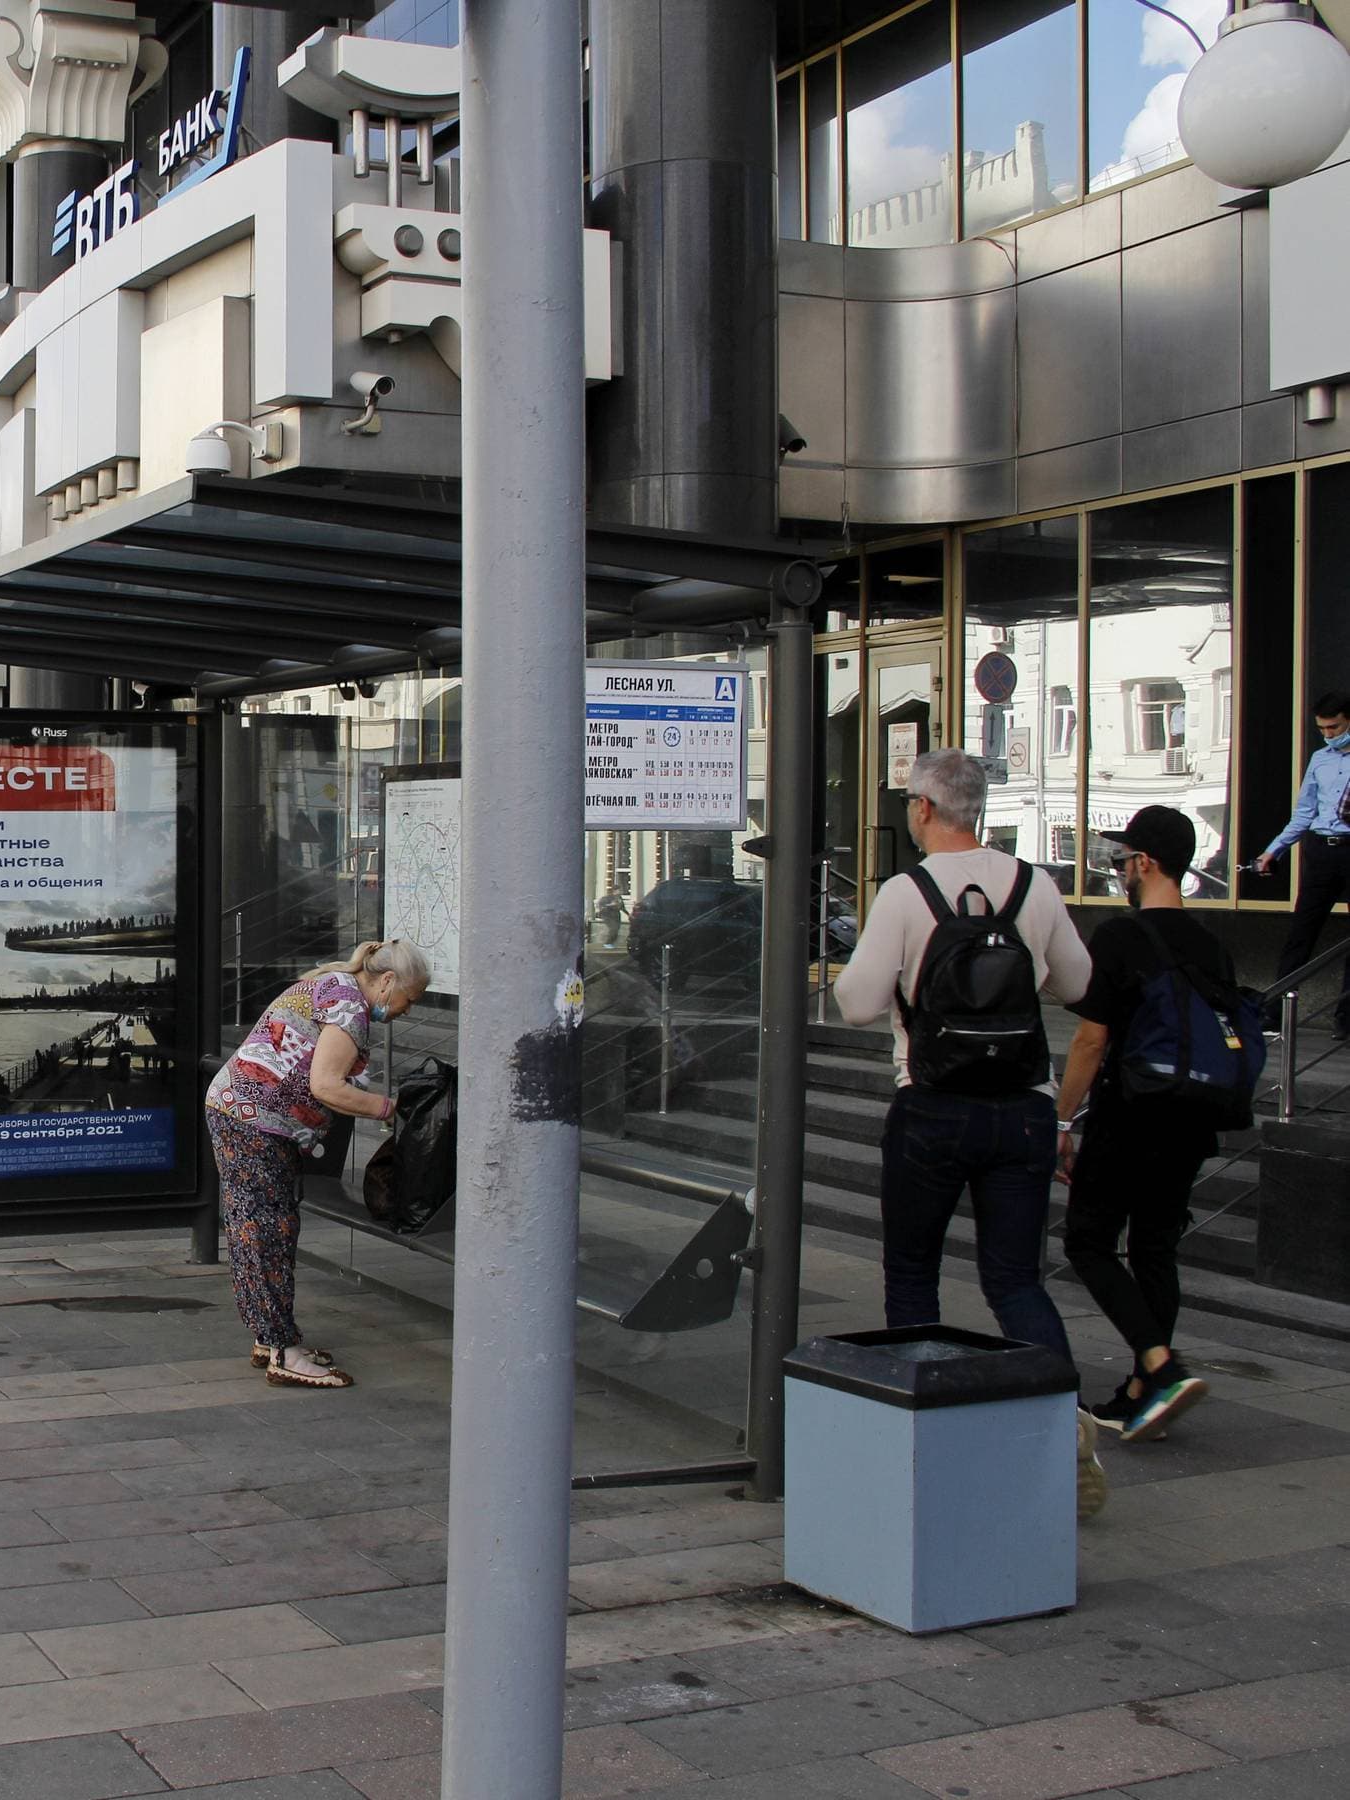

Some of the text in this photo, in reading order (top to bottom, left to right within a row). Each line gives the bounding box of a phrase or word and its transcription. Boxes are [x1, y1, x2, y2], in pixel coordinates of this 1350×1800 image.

[158, 89, 219, 176] БАНК
[75, 159, 137, 265] ВТБ
[605, 677, 676, 693] ЛЕСНАЯ УЛ.
[43, 727, 68, 737] Russ
[589, 723, 619, 735] МЕТРО
[586, 735, 638, 749] ТАЙ-ГОРОД"
[667, 731, 677, 742] 24
[588, 756, 618, 768] МЕТРО
[585, 768, 638, 779] ЯКОВСКАЯ"
[586, 794, 639, 808] ОТЁЧНАЯ ПЛ.
[14, 878, 24, 888] и
[27, 876, 103, 889] общения
[32, 1118, 38, 1127] В
[39, 1114, 127, 1127] ГОСУДАРСТВЕННУЮ
[127, 1113, 152, 1123] ДУМУ
[13, 1127, 83, 1140] сентября
[86, 1125, 123, 1136] 2021
